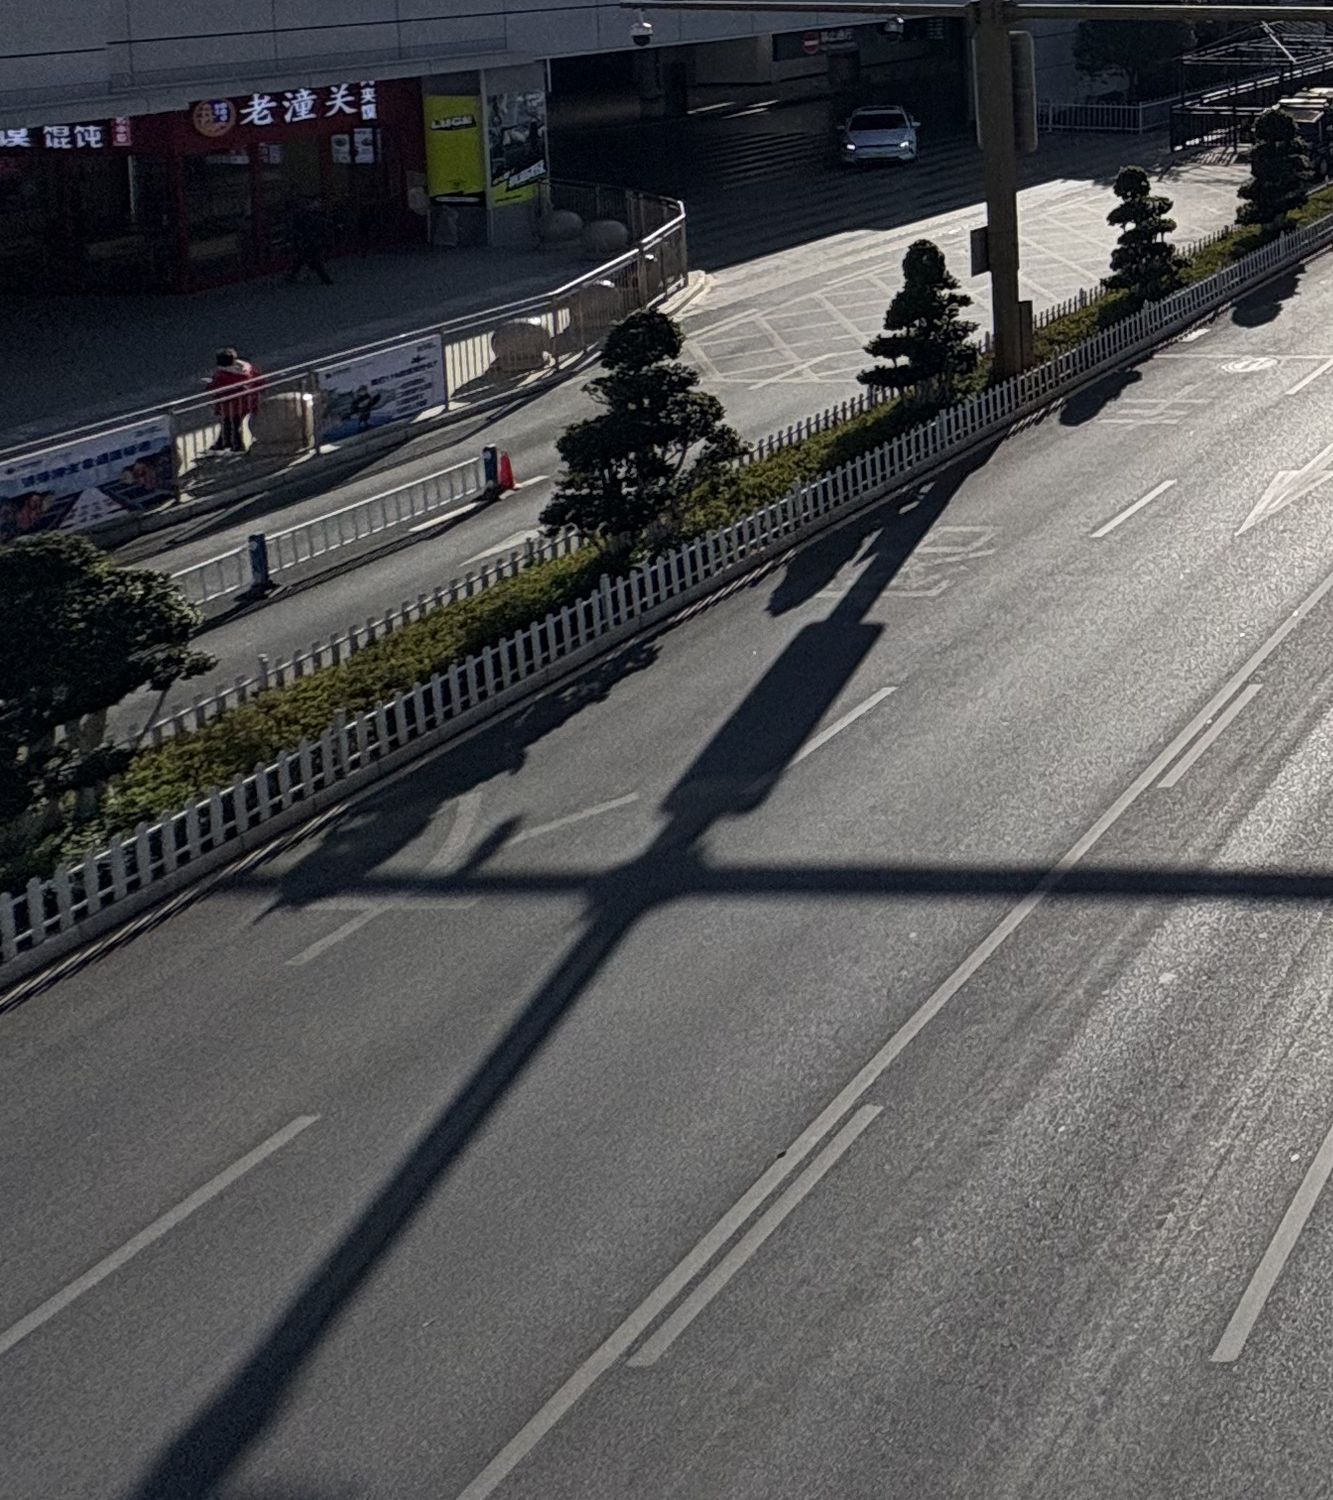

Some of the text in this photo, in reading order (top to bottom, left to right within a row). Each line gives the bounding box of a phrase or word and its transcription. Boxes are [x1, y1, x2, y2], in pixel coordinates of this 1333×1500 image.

[239, 83, 362, 127] 老潼关
[43, 125, 104, 150] 馄饨
